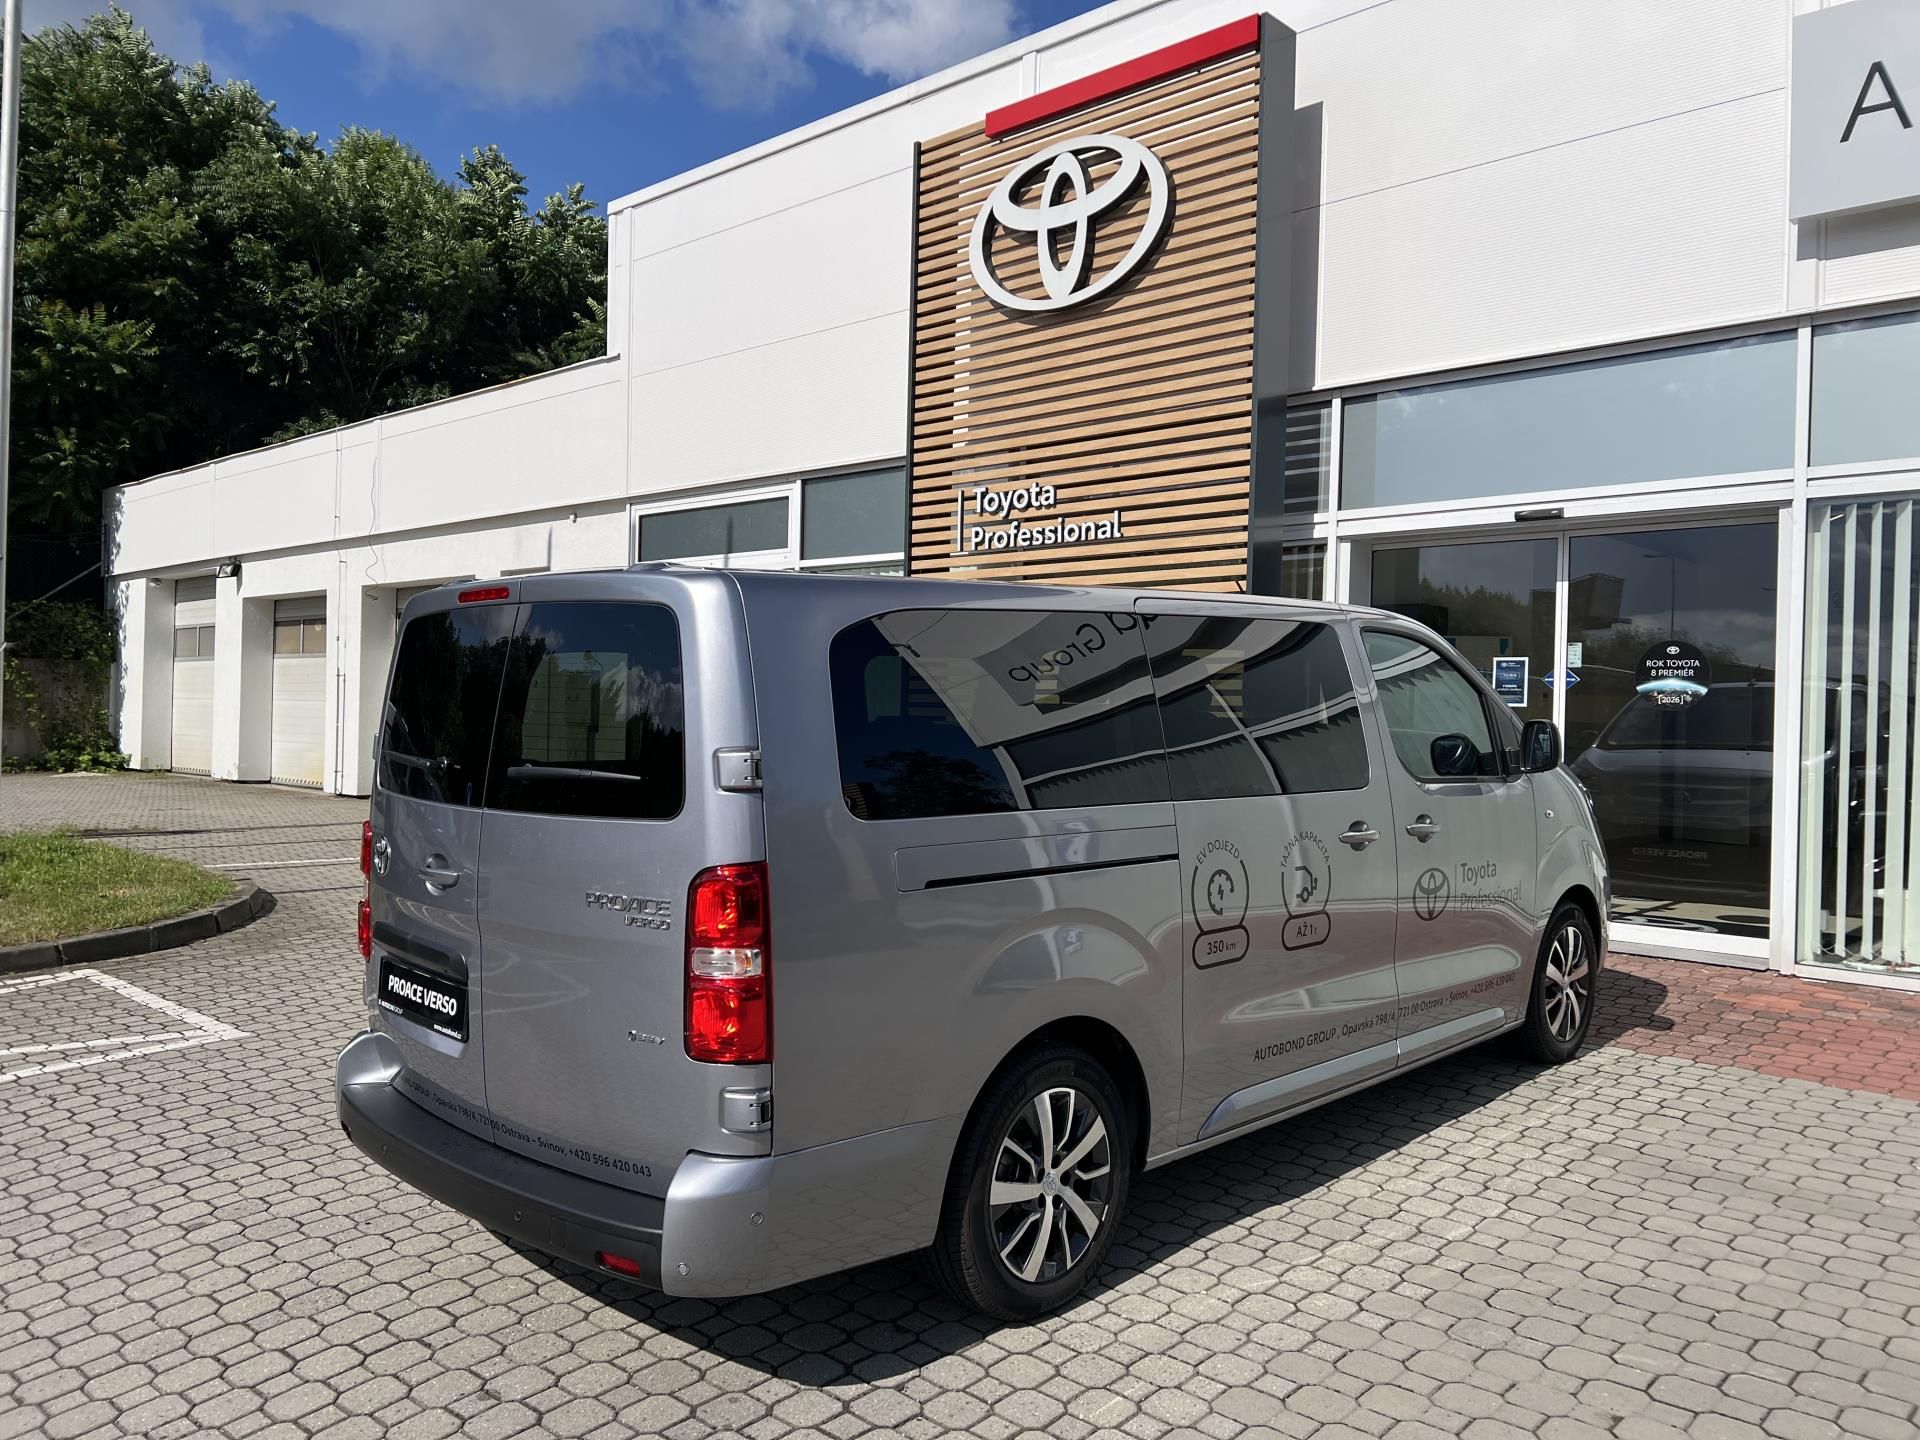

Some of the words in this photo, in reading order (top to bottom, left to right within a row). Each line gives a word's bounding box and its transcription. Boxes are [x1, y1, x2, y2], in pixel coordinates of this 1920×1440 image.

[1840, 60, 1914, 143] A
[973, 482, 1056, 520] Toyota
[971, 510, 1121, 551] Professional
[1646, 660, 1664, 668] ROK
[1665, 659, 1701, 668] TOYOTA
[1650, 669, 1657, 677] 8
[1658, 667, 1694, 677] PREMIÉR
[1197, 848, 1207, 865] EV
[1207, 839, 1240, 859] DOJEZD
[1299, 831, 1330, 864] KAPACITA
[1461, 860, 1497, 887] Toyota
[585, 892, 672, 917] PROACE
[1460, 880, 1522, 912] Professional
[624, 914, 671, 930] VERSO
[1296, 921, 1308, 938] AŽ
[1207, 940, 1225, 955] 350
[1225, 941, 1236, 951] km
[388, 974, 423, 1003] PROACE
[423, 988, 457, 1016] VERSO
[1253, 1037, 1305, 1062] AUTOBOND
[501, 1123, 531, 1143] Ostrava
[538, 1136, 568, 1157] Svinov,
[569, 1148, 591, 1162] +420
[593, 1152, 610, 1167] 596
[613, 1158, 631, 1172] 420
[633, 1163, 652, 1177] 043
